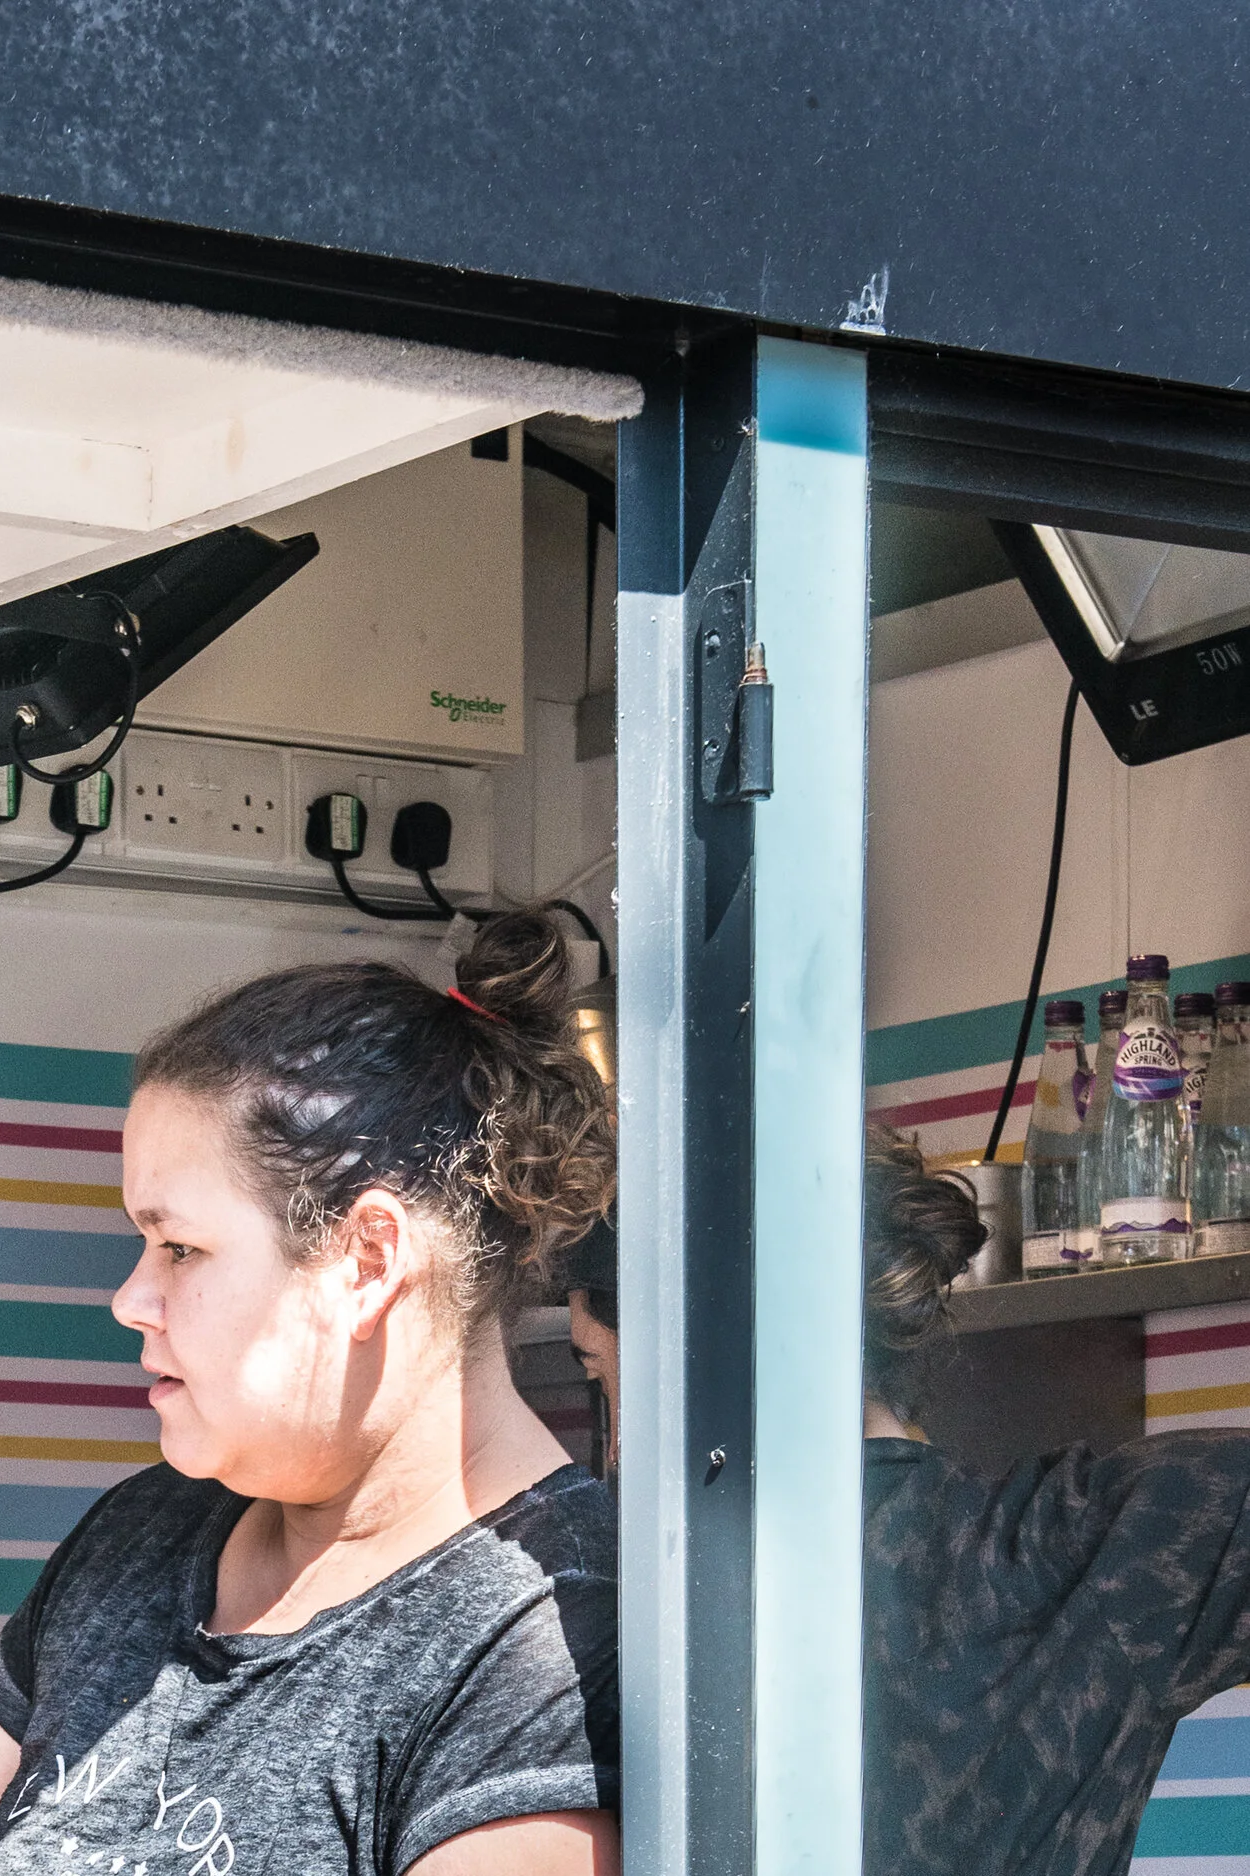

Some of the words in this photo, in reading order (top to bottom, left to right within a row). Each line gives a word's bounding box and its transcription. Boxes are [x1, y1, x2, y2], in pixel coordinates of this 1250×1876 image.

[1196, 642, 1243, 675] 50W
[430, 690, 507, 714] Schneider
[1130, 699, 1159, 721] LE
[1121, 1040, 1176, 1066] HIGHLAND
[1134, 1055, 1163, 1067] SPRING
